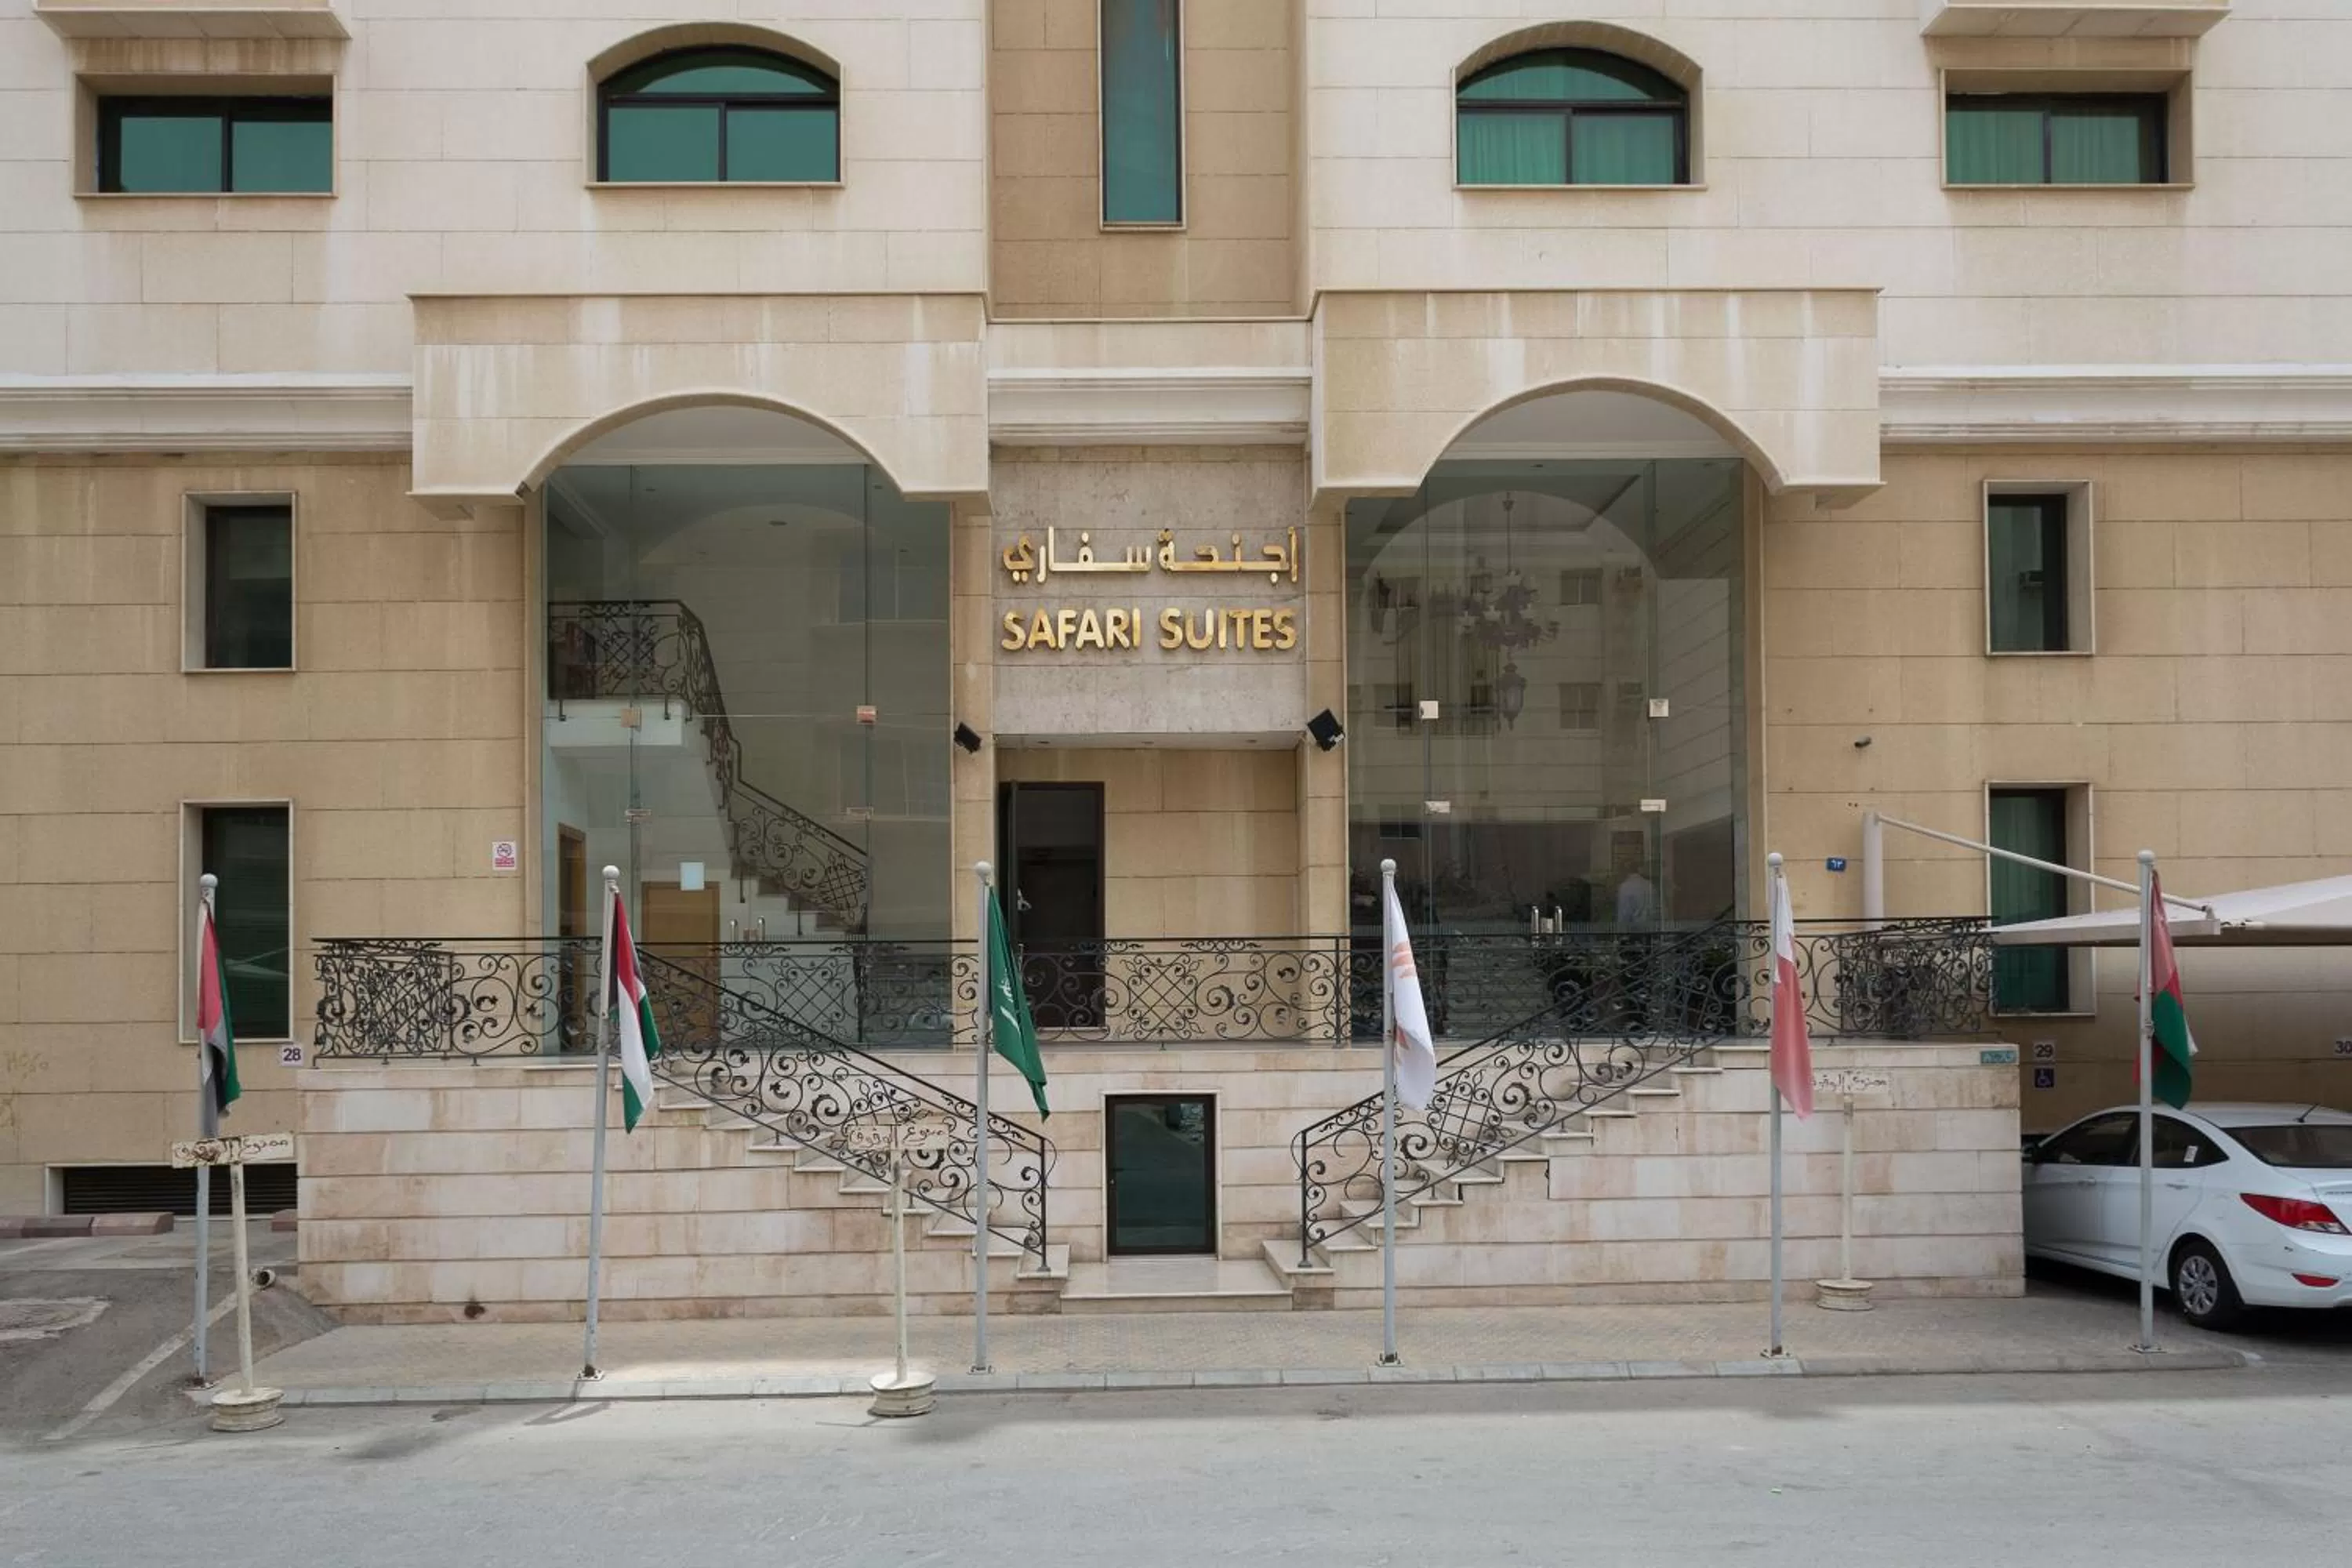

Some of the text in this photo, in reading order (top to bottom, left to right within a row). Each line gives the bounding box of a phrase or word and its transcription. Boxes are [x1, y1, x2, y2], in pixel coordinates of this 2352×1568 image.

[1003, 526, 1152, 584] سفاري
[1001, 607, 1298, 650] SAFARI SUITES
[282, 1047, 303, 1062] 28
[2035, 1044, 2054, 1058] 29
